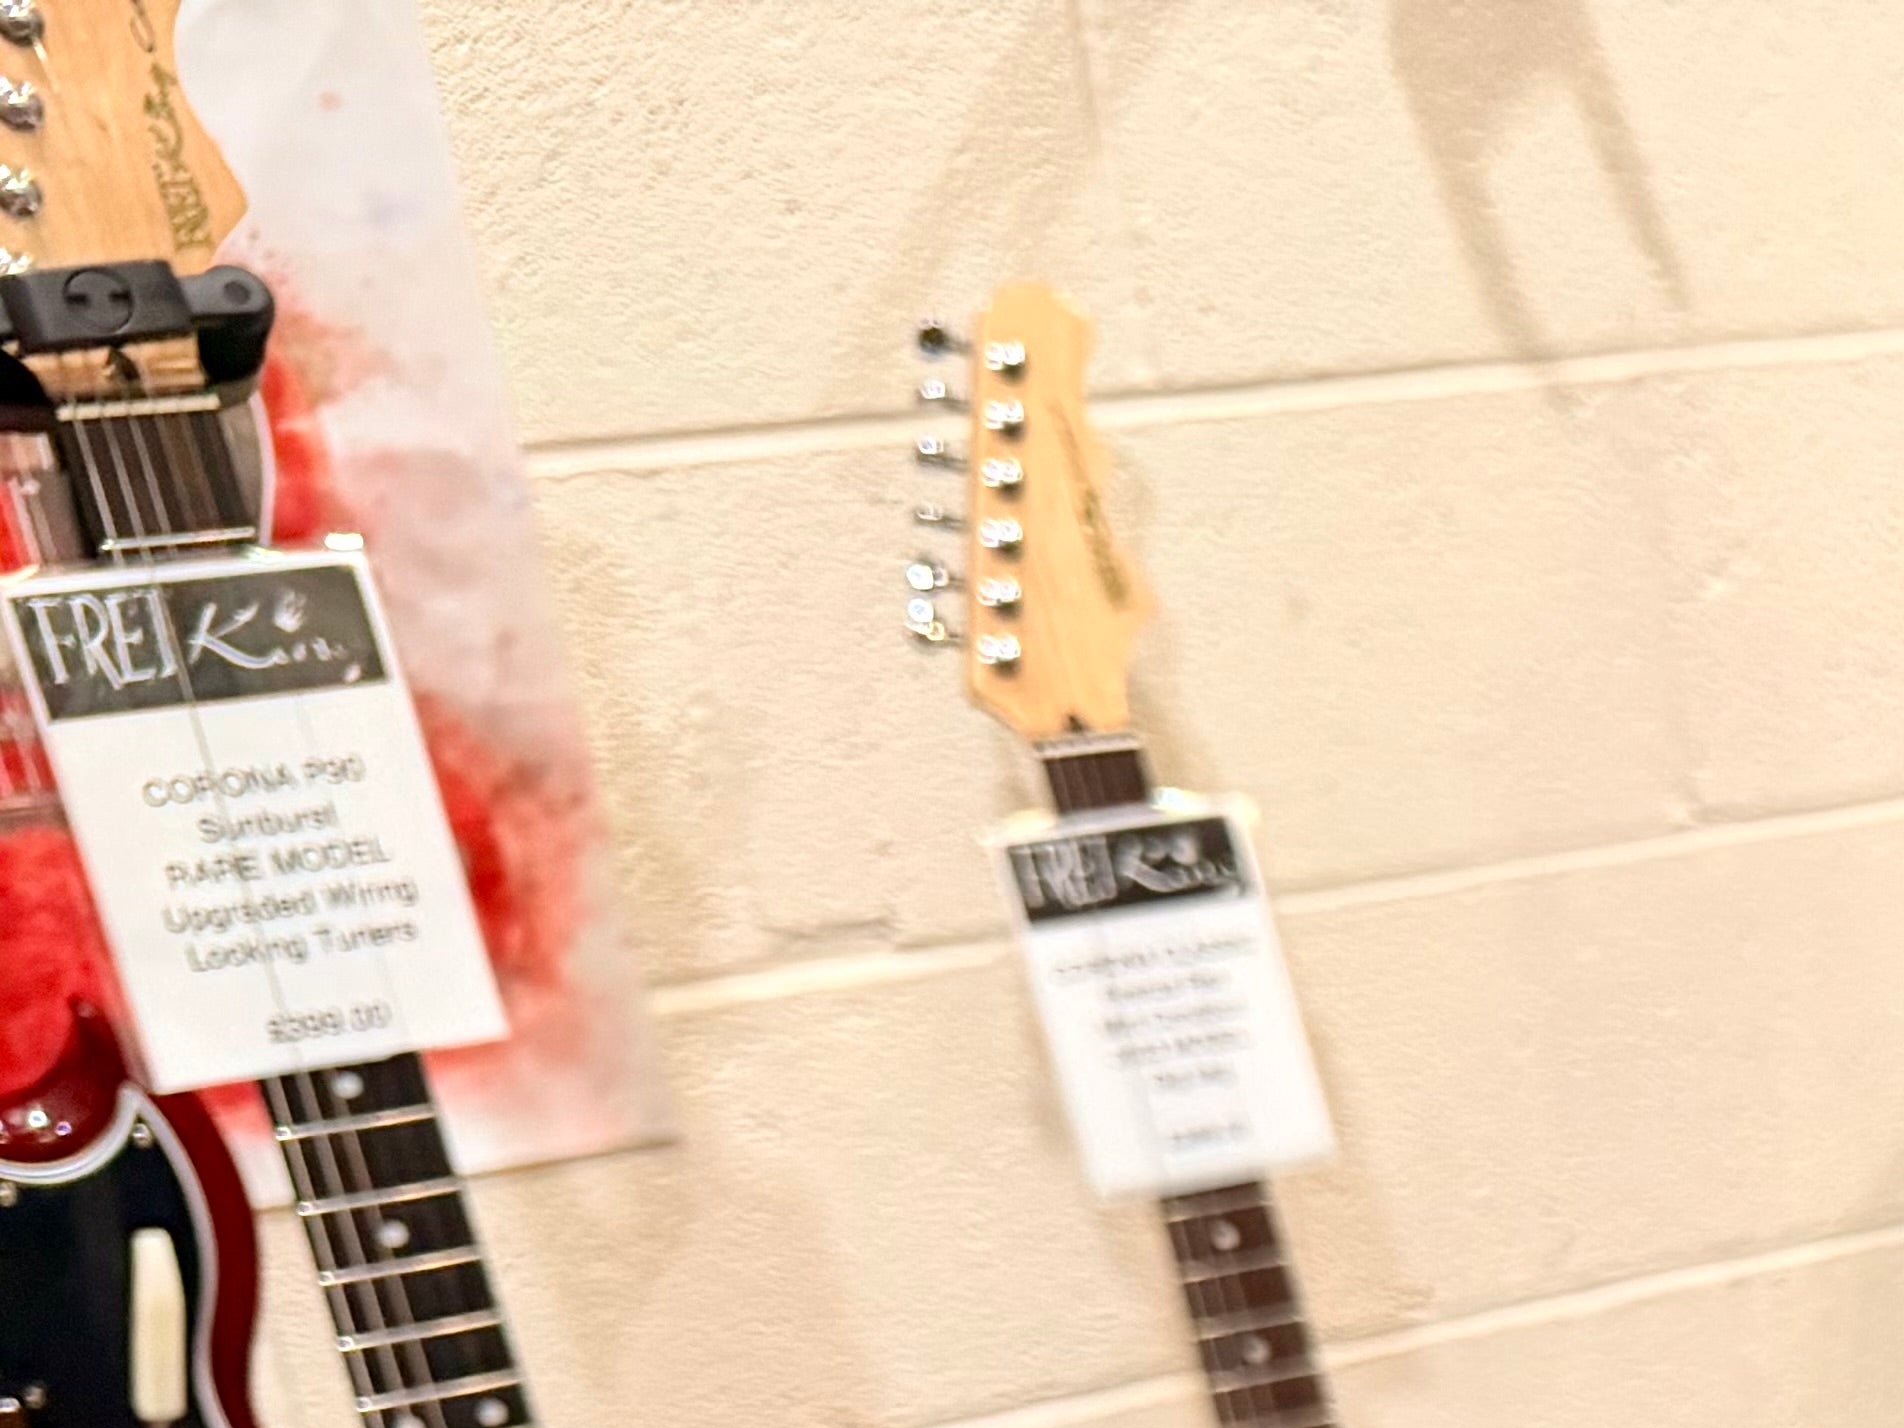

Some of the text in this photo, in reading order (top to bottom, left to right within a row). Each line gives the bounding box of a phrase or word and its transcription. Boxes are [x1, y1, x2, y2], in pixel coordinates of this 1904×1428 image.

[28, 589, 177, 690] FRET
[143, 764, 296, 807] CORONA
[198, 800, 338, 844] Sunburst
[165, 837, 391, 886] RARE MODEL
[163, 877, 419, 934] Upgraded Wiring
[184, 921, 419, 973] Locking Tuners
